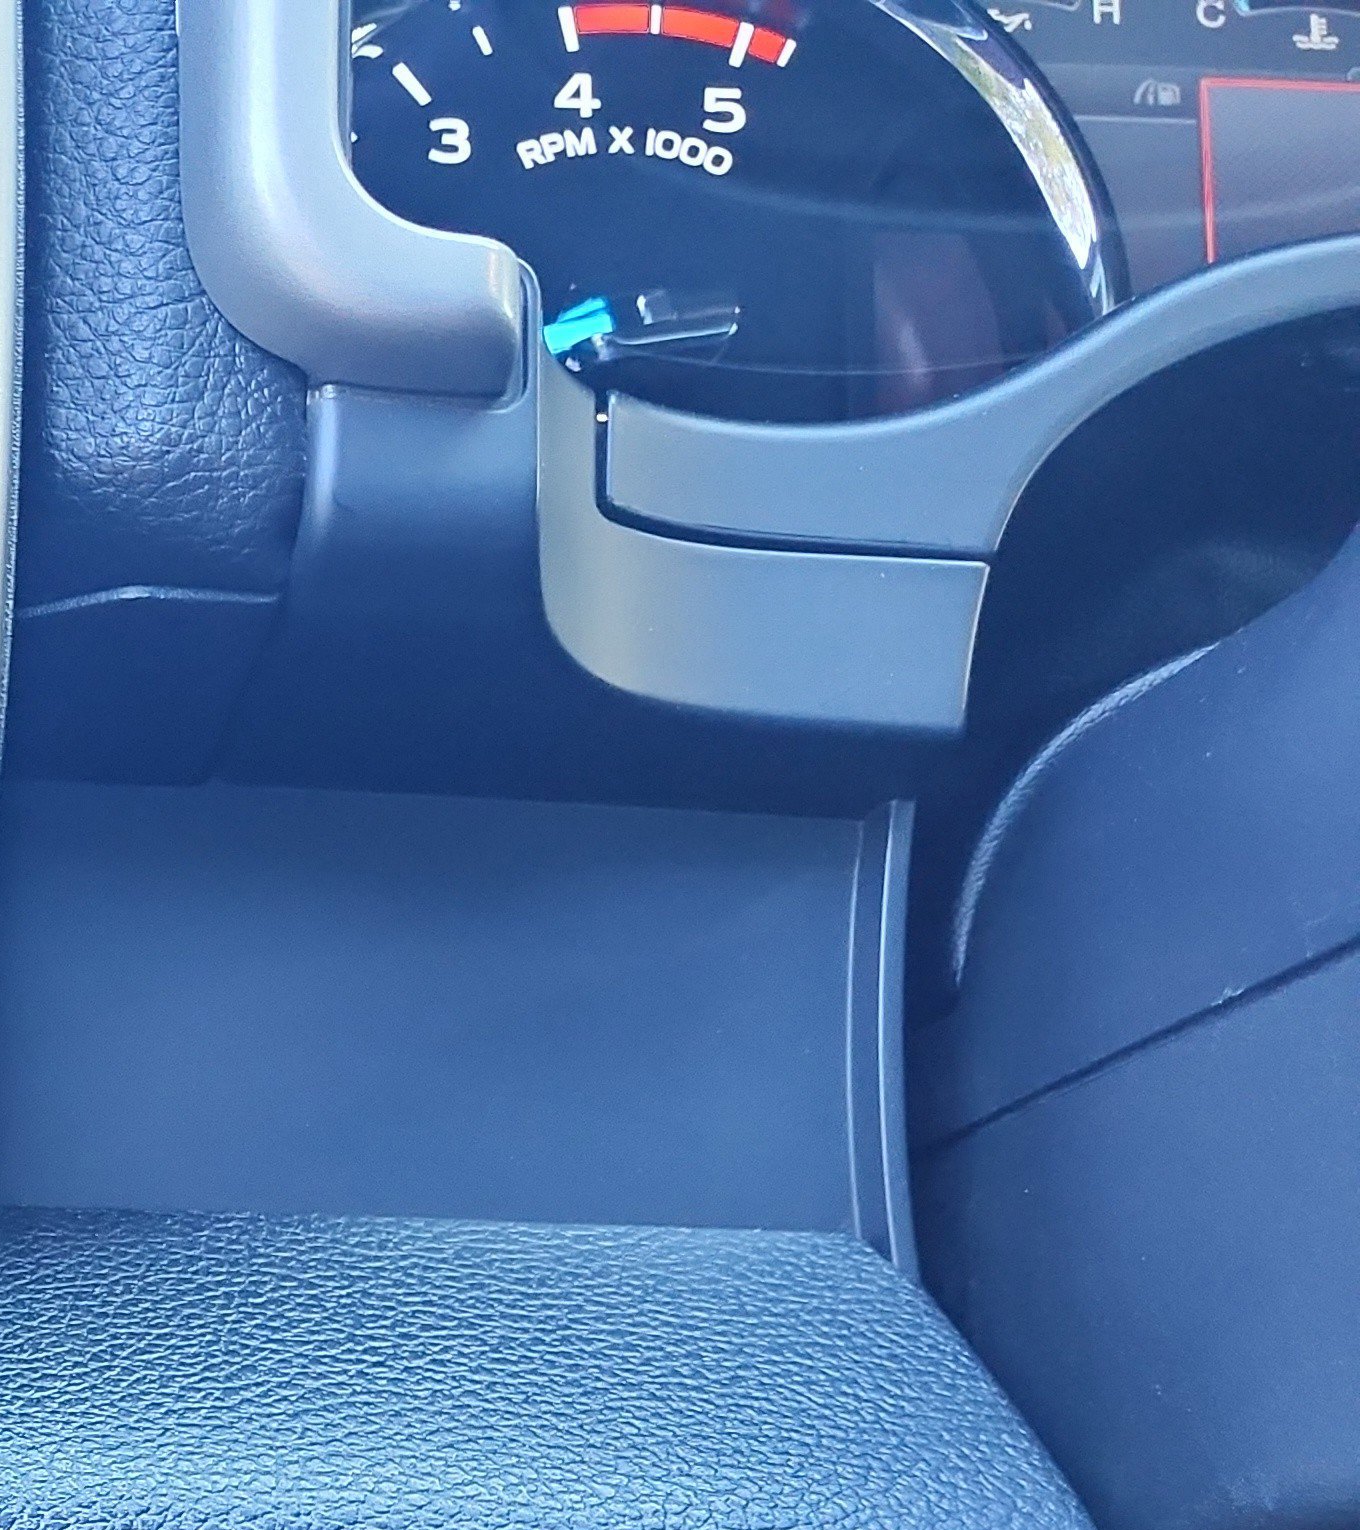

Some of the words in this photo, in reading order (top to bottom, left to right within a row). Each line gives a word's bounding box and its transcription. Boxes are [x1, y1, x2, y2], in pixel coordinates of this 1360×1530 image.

[554, 73, 601, 118] 4
[703, 87, 747, 133] 5
[428, 117, 472, 165] 3
[516, 127, 598, 170] RPM
[608, 125, 634, 155] X
[644, 127, 733, 176] 1000
